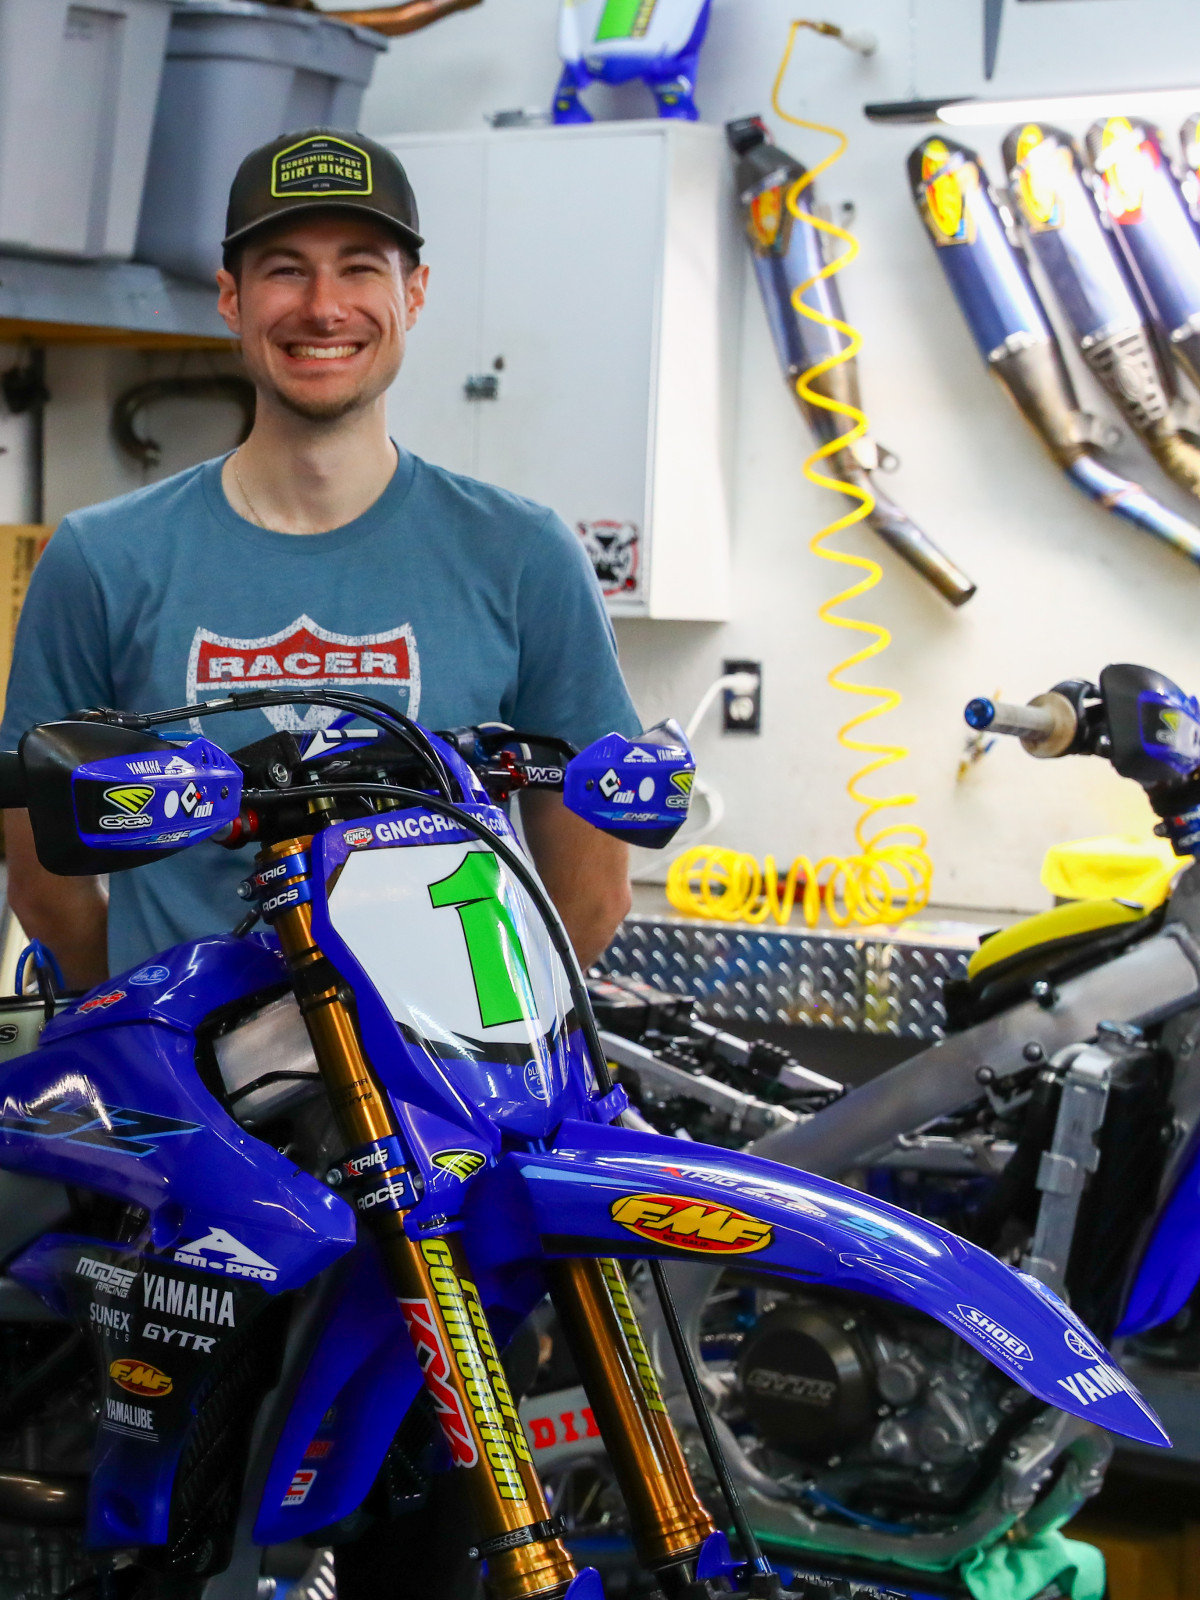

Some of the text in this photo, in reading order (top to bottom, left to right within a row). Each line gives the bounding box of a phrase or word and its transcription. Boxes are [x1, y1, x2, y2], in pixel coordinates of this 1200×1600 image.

[281, 154, 362, 171] SCREAMING-FAST
[281, 163, 362, 182] DIRT BIKES
[208, 652, 398, 679] RACER
[126, 760, 163, 775] YAMAHA
[102, 816, 151, 828] CYCRA
[256, 864, 288, 886] XTRIG
[262, 888, 299, 911] ROCS
[427, 850, 539, 1029] 1
[343, 1148, 389, 1176] XTRIG
[658, 1166, 742, 1187] XTRIG
[357, 1181, 404, 1210] ROCS
[612, 1198, 774, 1244] FMF
[75, 1256, 138, 1289] MOOSE
[95, 1281, 129, 1299] RACING
[143, 1272, 236, 1328] YAMAHA
[89, 1302, 131, 1333] SUNEX
[90, 1323, 130, 1343] TOOLS
[142, 1322, 217, 1354] GYTR
[948, 1310, 1024, 1371] PREMIUM HELMETS
[966, 1310, 1026, 1356] SHOEI
[109, 1362, 173, 1390] FMF
[419, 1238, 527, 1501] Connection
[106, 1397, 154, 1430] YAMALUBE
